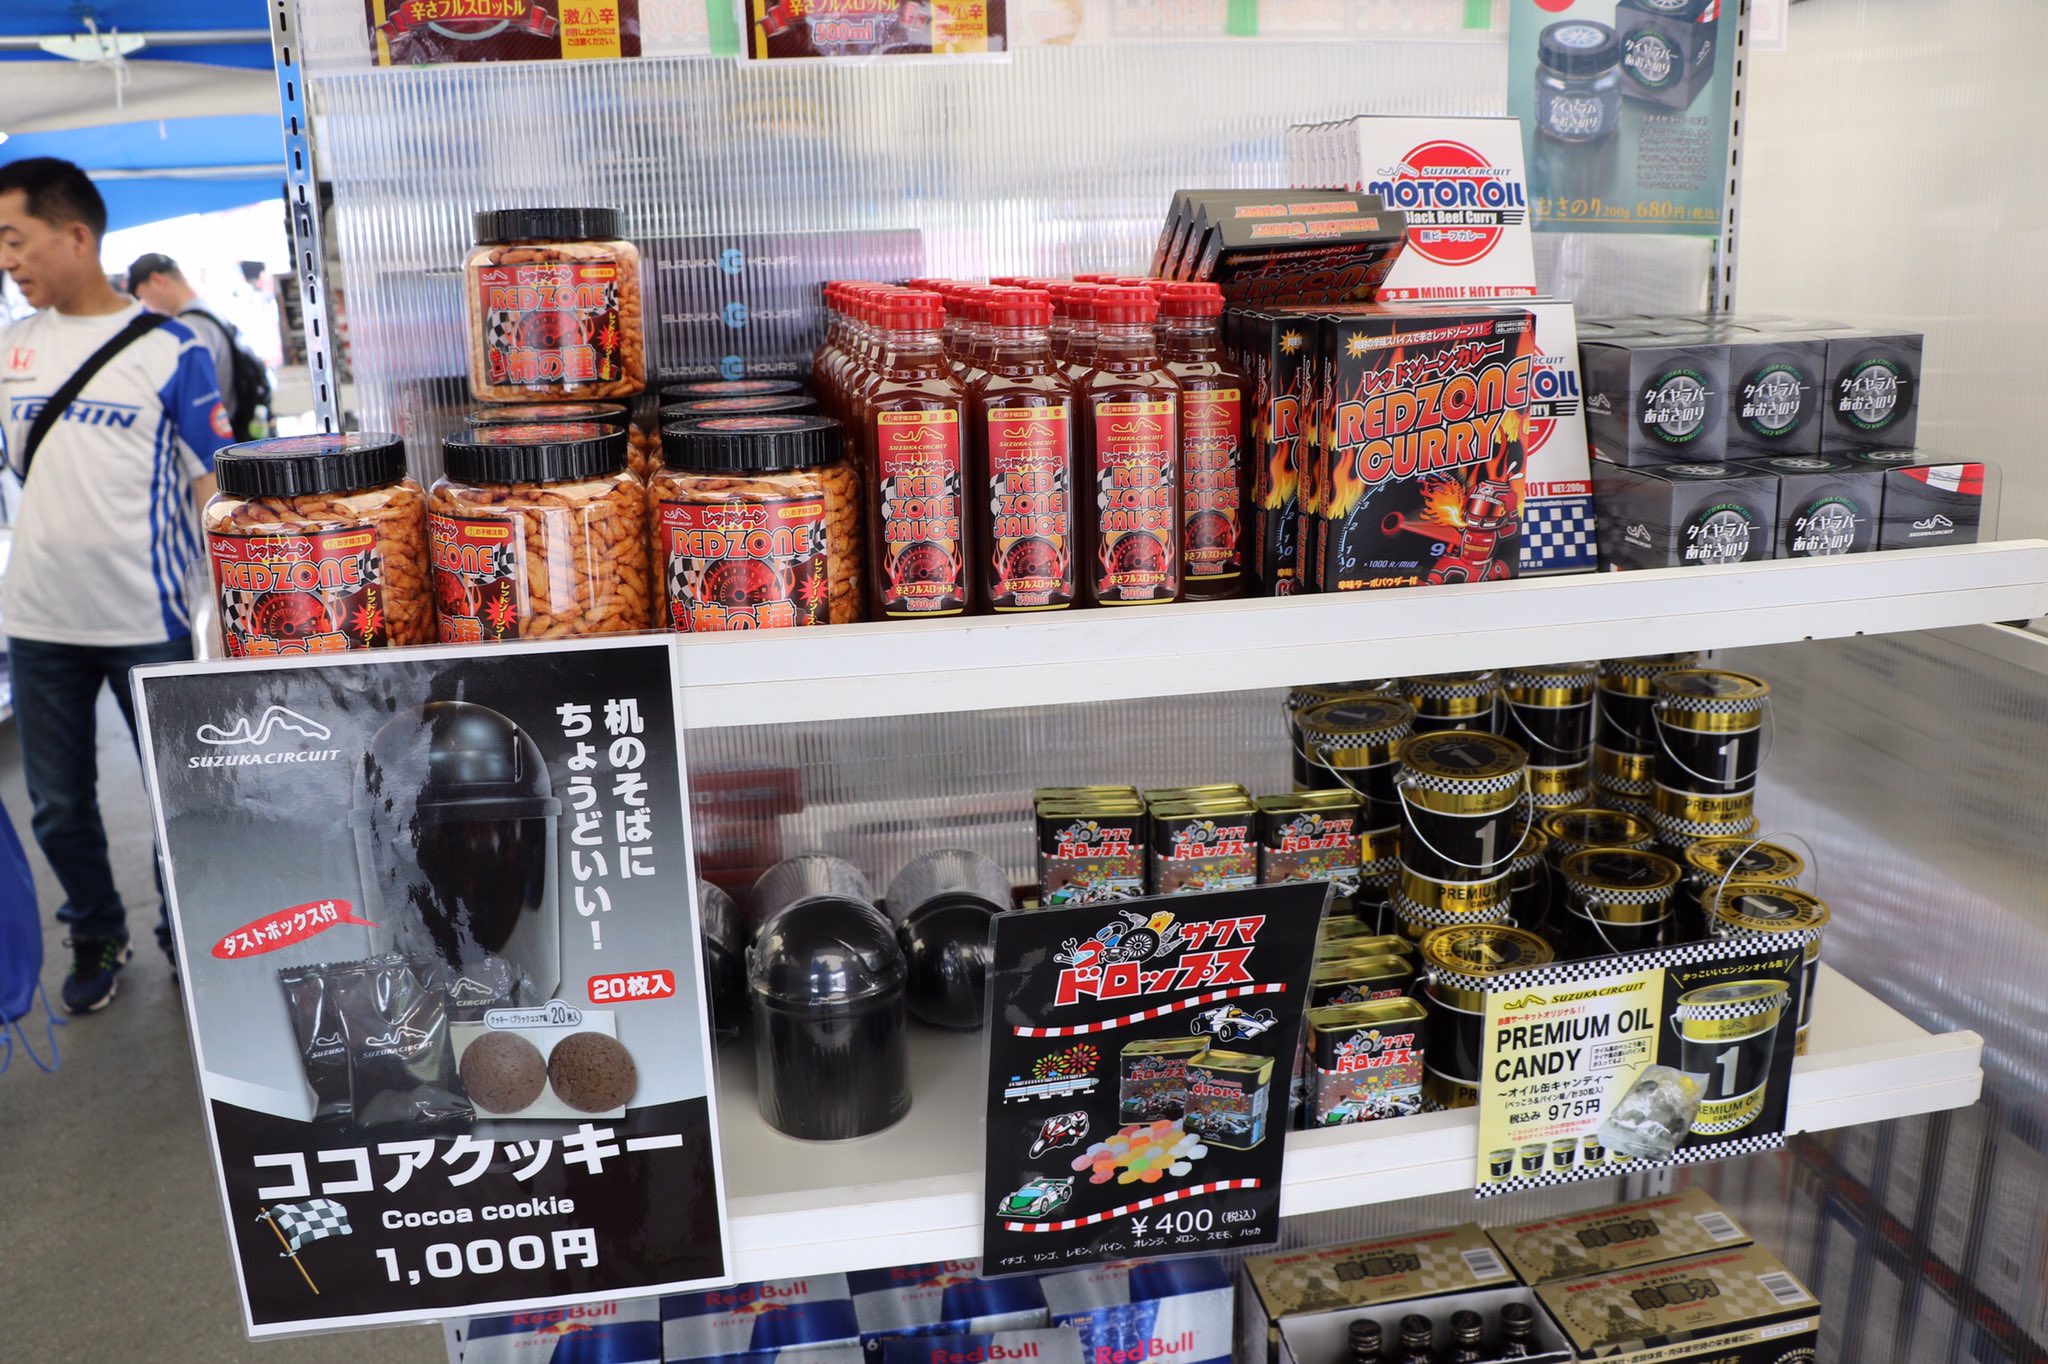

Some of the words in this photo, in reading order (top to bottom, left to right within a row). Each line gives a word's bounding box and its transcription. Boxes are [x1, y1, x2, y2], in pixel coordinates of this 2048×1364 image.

[563, 9, 580, 25] 激
[599, 9, 615, 25] 辛
[817, 21, 873, 41] 500ml
[1368, 180, 1477, 208] MOTOR
[1482, 181, 1526, 208] OIL
[1437, 210, 1463, 225] Beef
[1465, 210, 1498, 226] Curry
[491, 285, 606, 310] REDZONE
[509, 346, 597, 383] 柿の種
[1364, 340, 1504, 394] レッドゾーンカレー
[1535, 371, 1579, 398] OIL
[1645, 387, 1715, 404] タイヤラバー
[1743, 381, 1811, 399] タイヤラバー
[1840, 376, 1907, 393] タイヤラバー
[1337, 356, 1532, 448] REDZONE
[1742, 400, 1800, 418] あおさのり
[1839, 394, 1897, 411] あおさのり
[1644, 406, 1705, 424] あおさのり
[1358, 414, 1503, 483] CURRY
[1186, 451, 1229, 470] RED
[895, 477, 945, 497] RED
[1005, 473, 1054, 493] RED
[1113, 467, 1162, 488] RED
[1184, 469, 1237, 491] ZONE
[890, 498, 954, 519] ZONE
[999, 493, 1063, 515] ZONE
[1106, 487, 1168, 509] ZONE
[1185, 489, 1240, 510] AUCE
[886, 518, 959, 542] SAUCE
[995, 514, 1067, 538] SAUCE
[1101, 509, 1173, 531] SAUCE
[1687, 521, 1761, 540] タイヤラバー
[1795, 514, 1866, 532] タイヤラバー
[672, 526, 812, 558] REDZONE
[1430, 543, 1446, 557] 9
[1685, 541, 1749, 560] あおさのり
[1793, 533, 1854, 552] あおさのり
[221, 556, 361, 592] REDZONE
[1718, 738, 1740, 790] 1
[603, 698, 656, 879] 机のそばに
[556, 701, 613, 950] ちょうどいい!
[1100, 827, 1132, 841] サクマ
[1216, 825, 1247, 840] サクマ
[1323, 818, 1353, 833] サクマ
[1057, 841, 1131, 860] ドロップス
[1174, 840, 1247, 860] ドロップス
[1280, 832, 1353, 853] ドロップス
[1475, 819, 1497, 876] 1
[223, 902, 339, 957] ダストボックス付
[1178, 914, 1266, 951] サクマ
[593, 973, 672, 1000] 20枚入
[1053, 946, 1255, 1007] ドロップス
[1496, 1013, 1610, 1053] PREMIUM
[1617, 1007, 1654, 1034] OIL
[312, 1046, 345, 1058] SUZUKA
[1381, 1033, 1415, 1050] サクマ
[1335, 1048, 1412, 1074] ドロップス
[1495, 1047, 1582, 1083] CANDY
[1716, 1046, 1739, 1097] 1
[1192, 1081, 1242, 1099] drops
[1509, 1110, 1541, 1125] 税込み
[1548, 1098, 1600, 1121] 975円
[252, 1123, 684, 1200] ココアクッキー
[382, 1205, 473, 1230] Cocoa
[482, 1195, 575, 1221] cookie
[1221, 1208, 1257, 1224] (税込)
[1240, 1226, 1261, 1237] ハッカ
[375, 1227, 600, 1285] 1,000円
[705, 1289, 756, 1308] Red
[761, 1281, 809, 1299] Bull
[512, 1307, 564, 1327] Red
[568, 1301, 618, 1319] Bull
[866, 1338, 879, 1351] 6
[930, 1347, 983, 1364] Red
[987, 1342, 1039, 1359] Bull
[1095, 1341, 1144, 1364] Red
[1147, 1331, 1196, 1355] Bull
